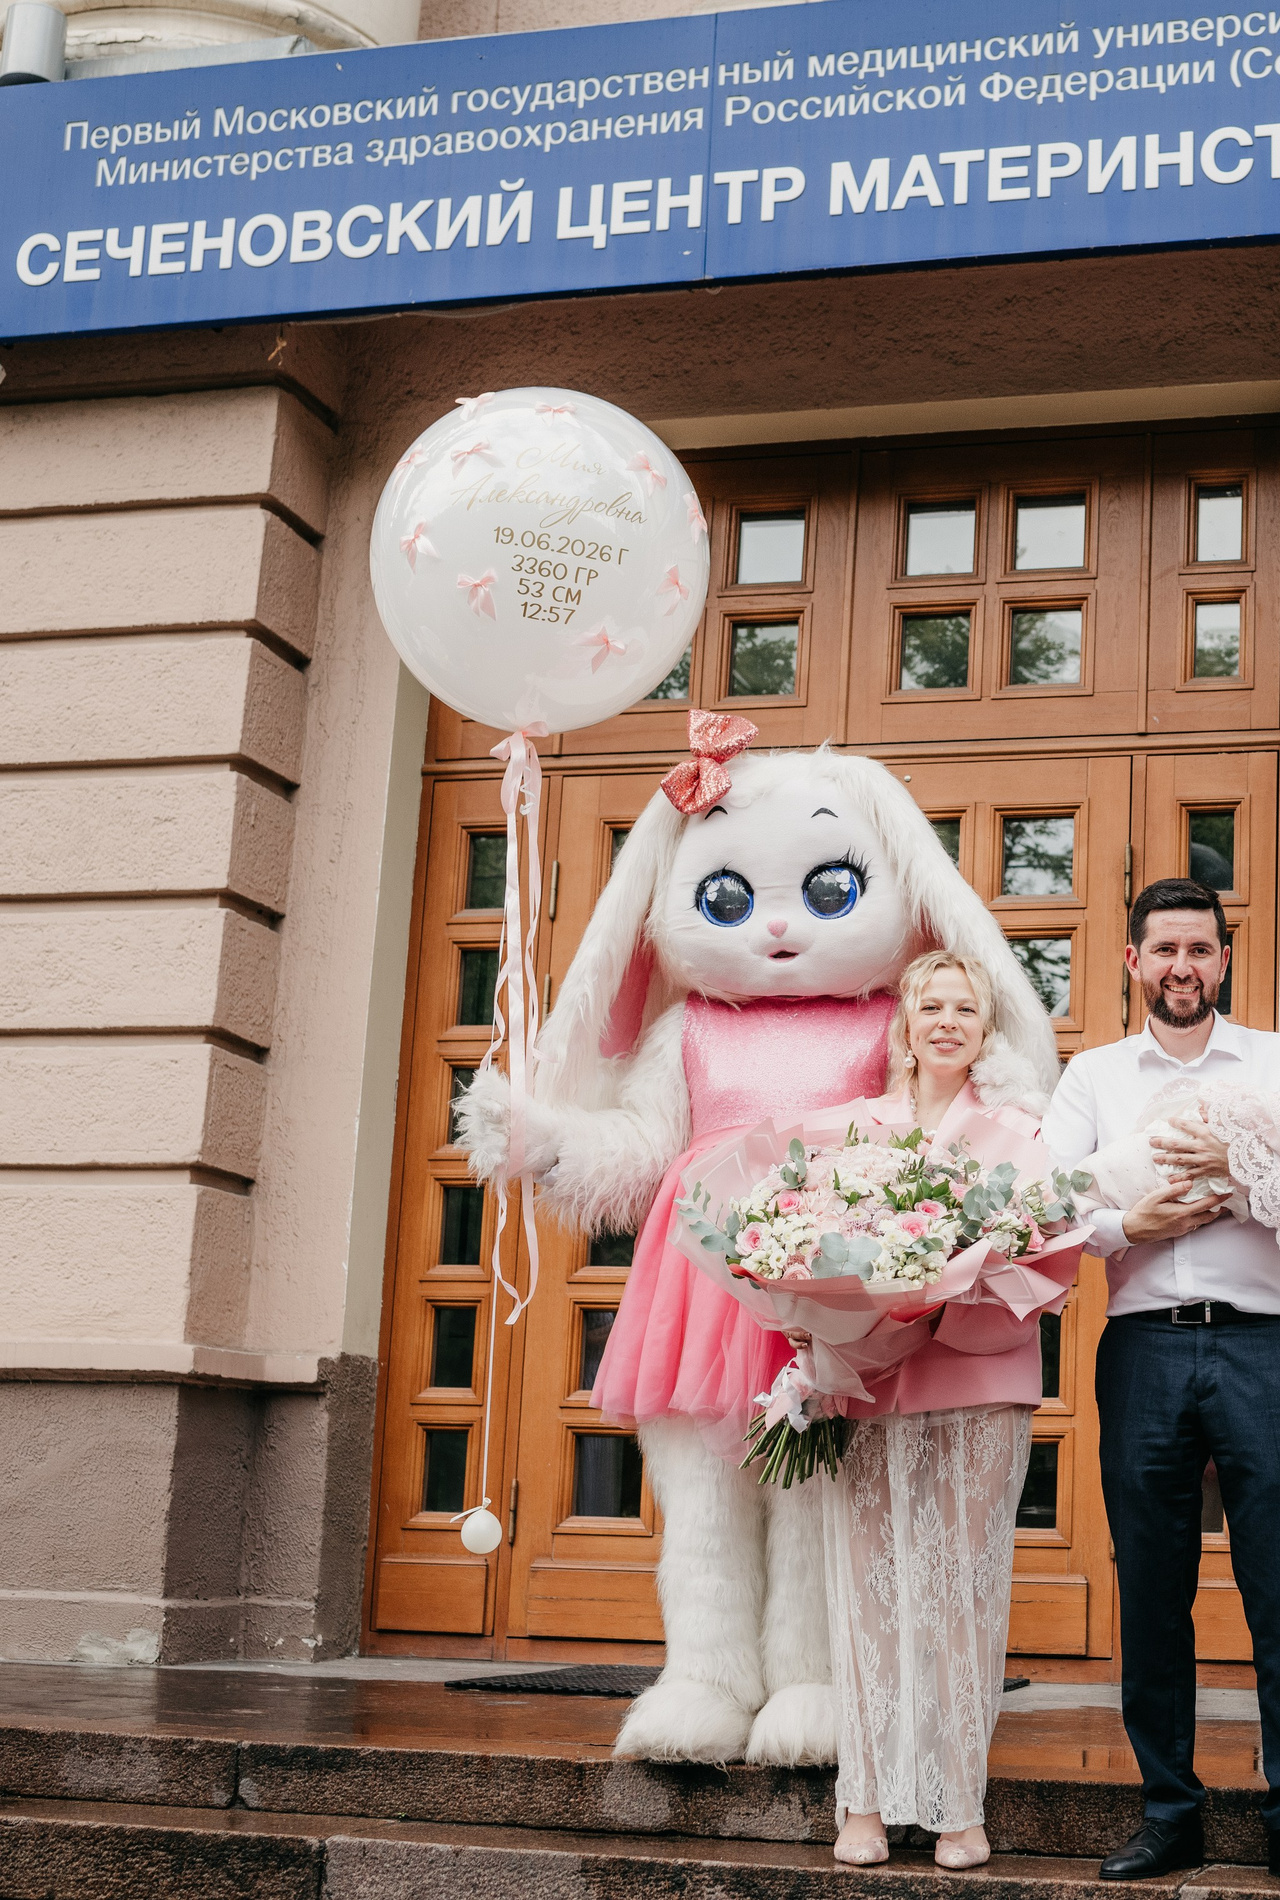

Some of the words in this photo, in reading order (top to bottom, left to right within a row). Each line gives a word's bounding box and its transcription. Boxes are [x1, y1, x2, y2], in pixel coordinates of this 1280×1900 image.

[63, 110, 201, 152] Первый
[212, 86, 439, 138] Московский
[807, 22, 1079, 80] медицинский
[95, 142, 355, 188] Министерства
[364, 104, 706, 168] здравоохранения
[723, 73, 967, 128] Российской
[979, 54, 1216, 104] Федерации
[16, 177, 535, 285] СЕЧЕНОВСКИЙ
[556, 167, 806, 249] ЦЕНТР
[451, 472, 648, 529] Александровна
[493, 526, 613, 562] 19.06.2026
[617, 548, 630, 565] Г
[511, 554, 568, 581] 3360
[574, 566, 599, 586] ГР
[517, 577, 545, 598] 53
[551, 585, 582, 606] СМ
[520, 601, 576, 625] 12:57
